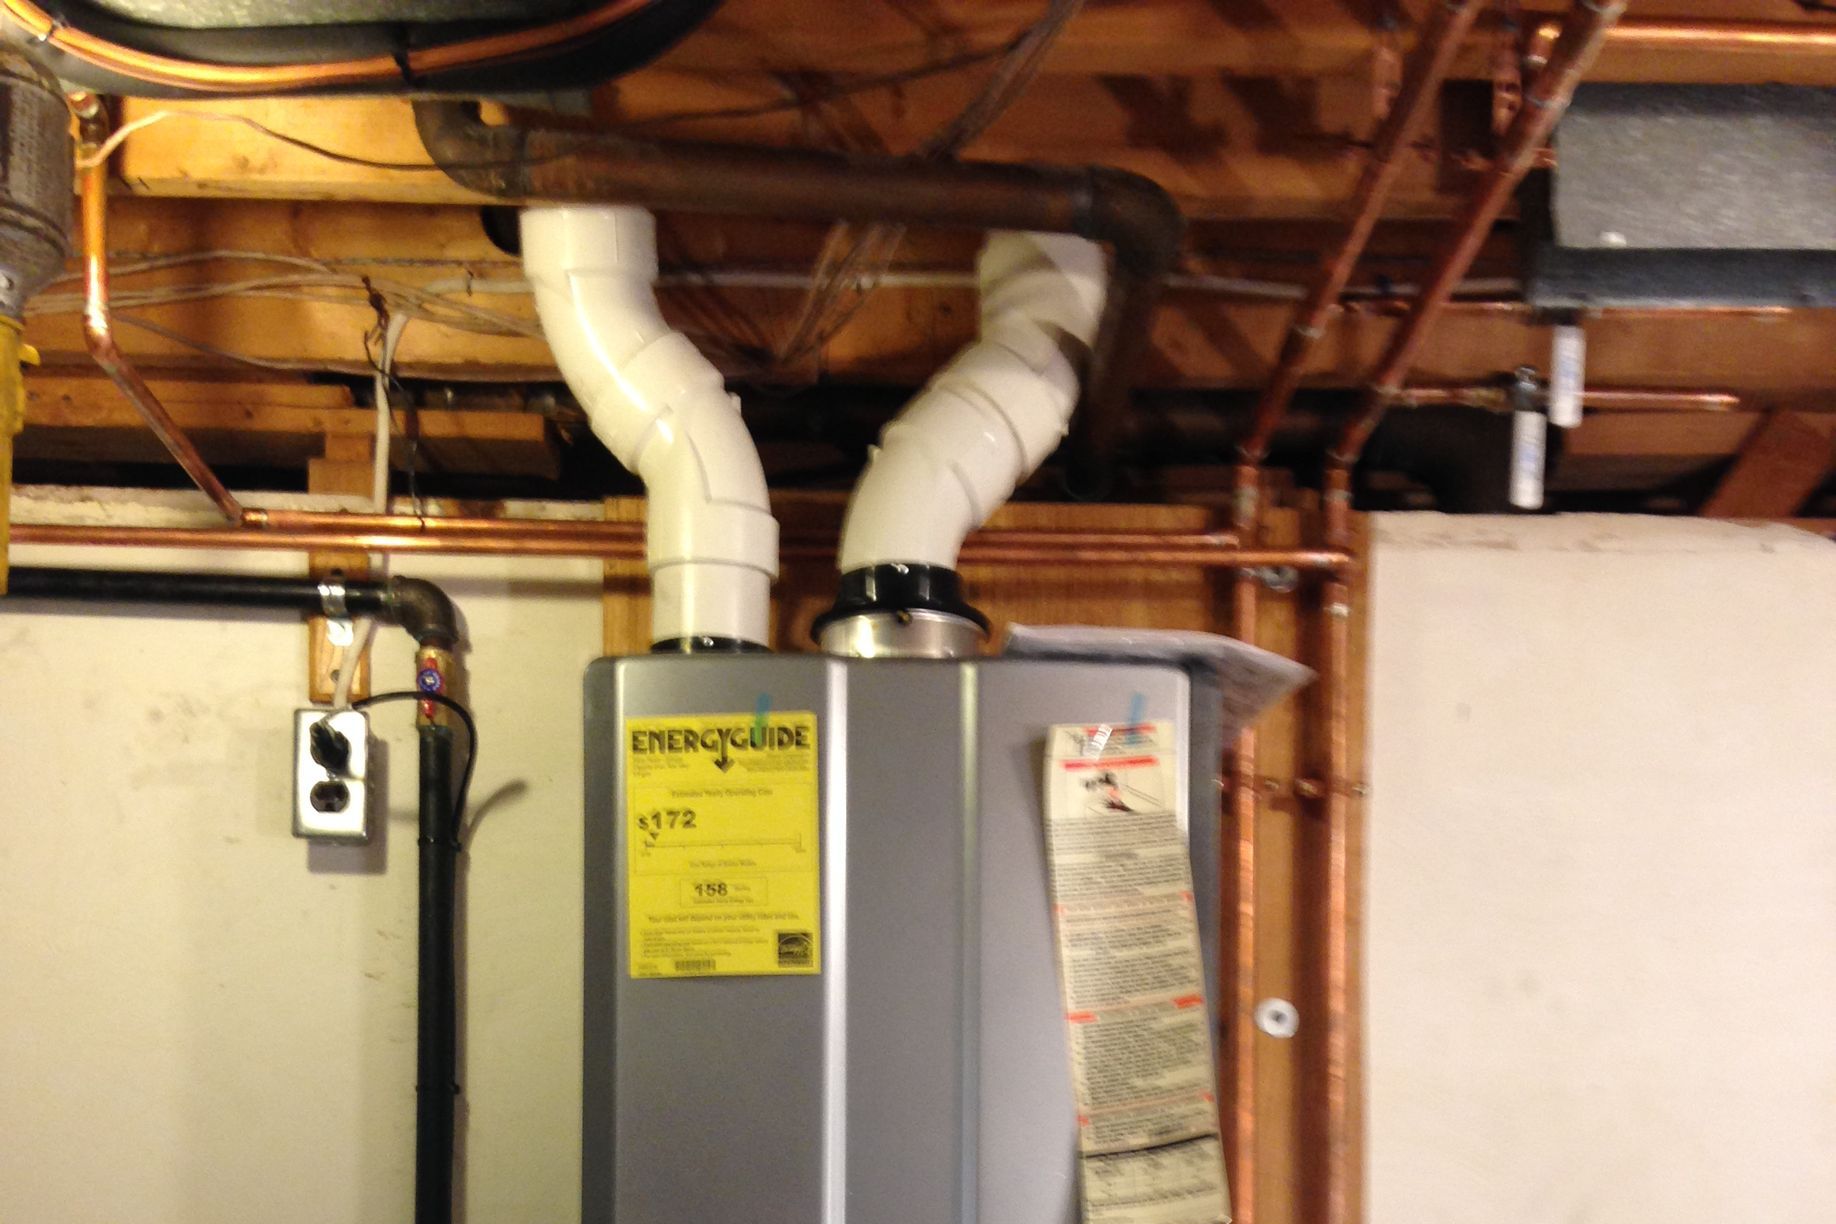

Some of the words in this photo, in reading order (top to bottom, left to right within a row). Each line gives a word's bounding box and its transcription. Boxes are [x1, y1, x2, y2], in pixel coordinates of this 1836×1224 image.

[631, 726, 811, 758] ENERGYGUIDE
[637, 808, 697, 831] $172
[694, 882, 728, 897] 158
